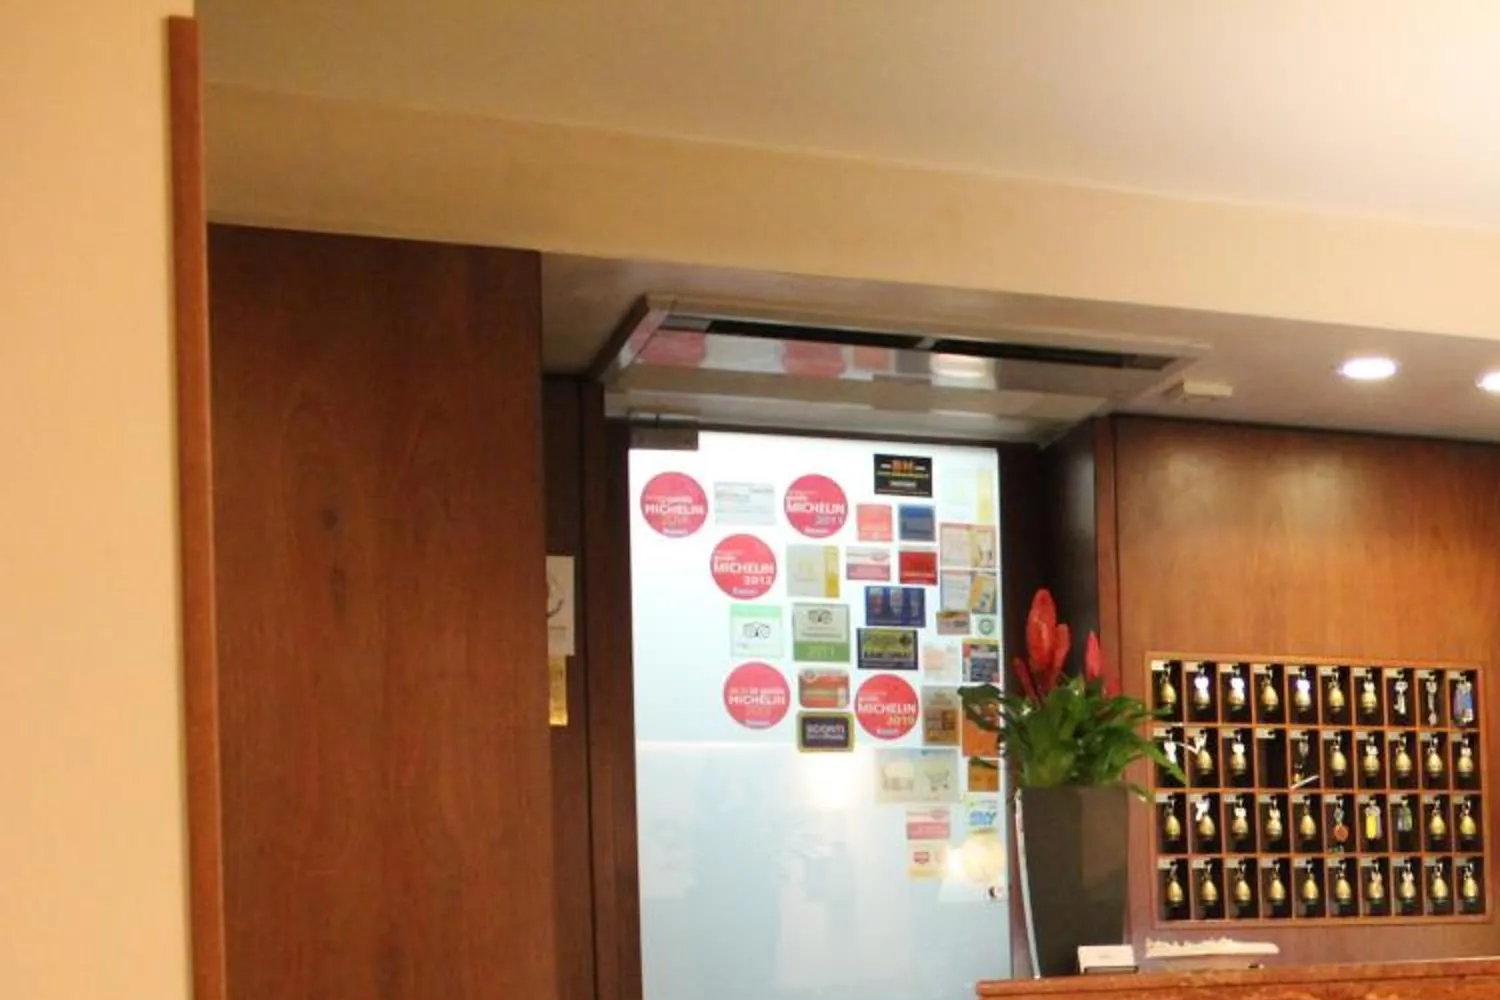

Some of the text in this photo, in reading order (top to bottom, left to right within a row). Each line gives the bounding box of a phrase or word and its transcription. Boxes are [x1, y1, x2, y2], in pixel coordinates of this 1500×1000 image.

[644, 502, 705, 516] MICHELIN
[786, 500, 846, 514] MICHELIN
[714, 561, 775, 574] MICHELIN
[728, 694, 786, 705] MICHELIN
[857, 701, 917, 715] MICHELIN
